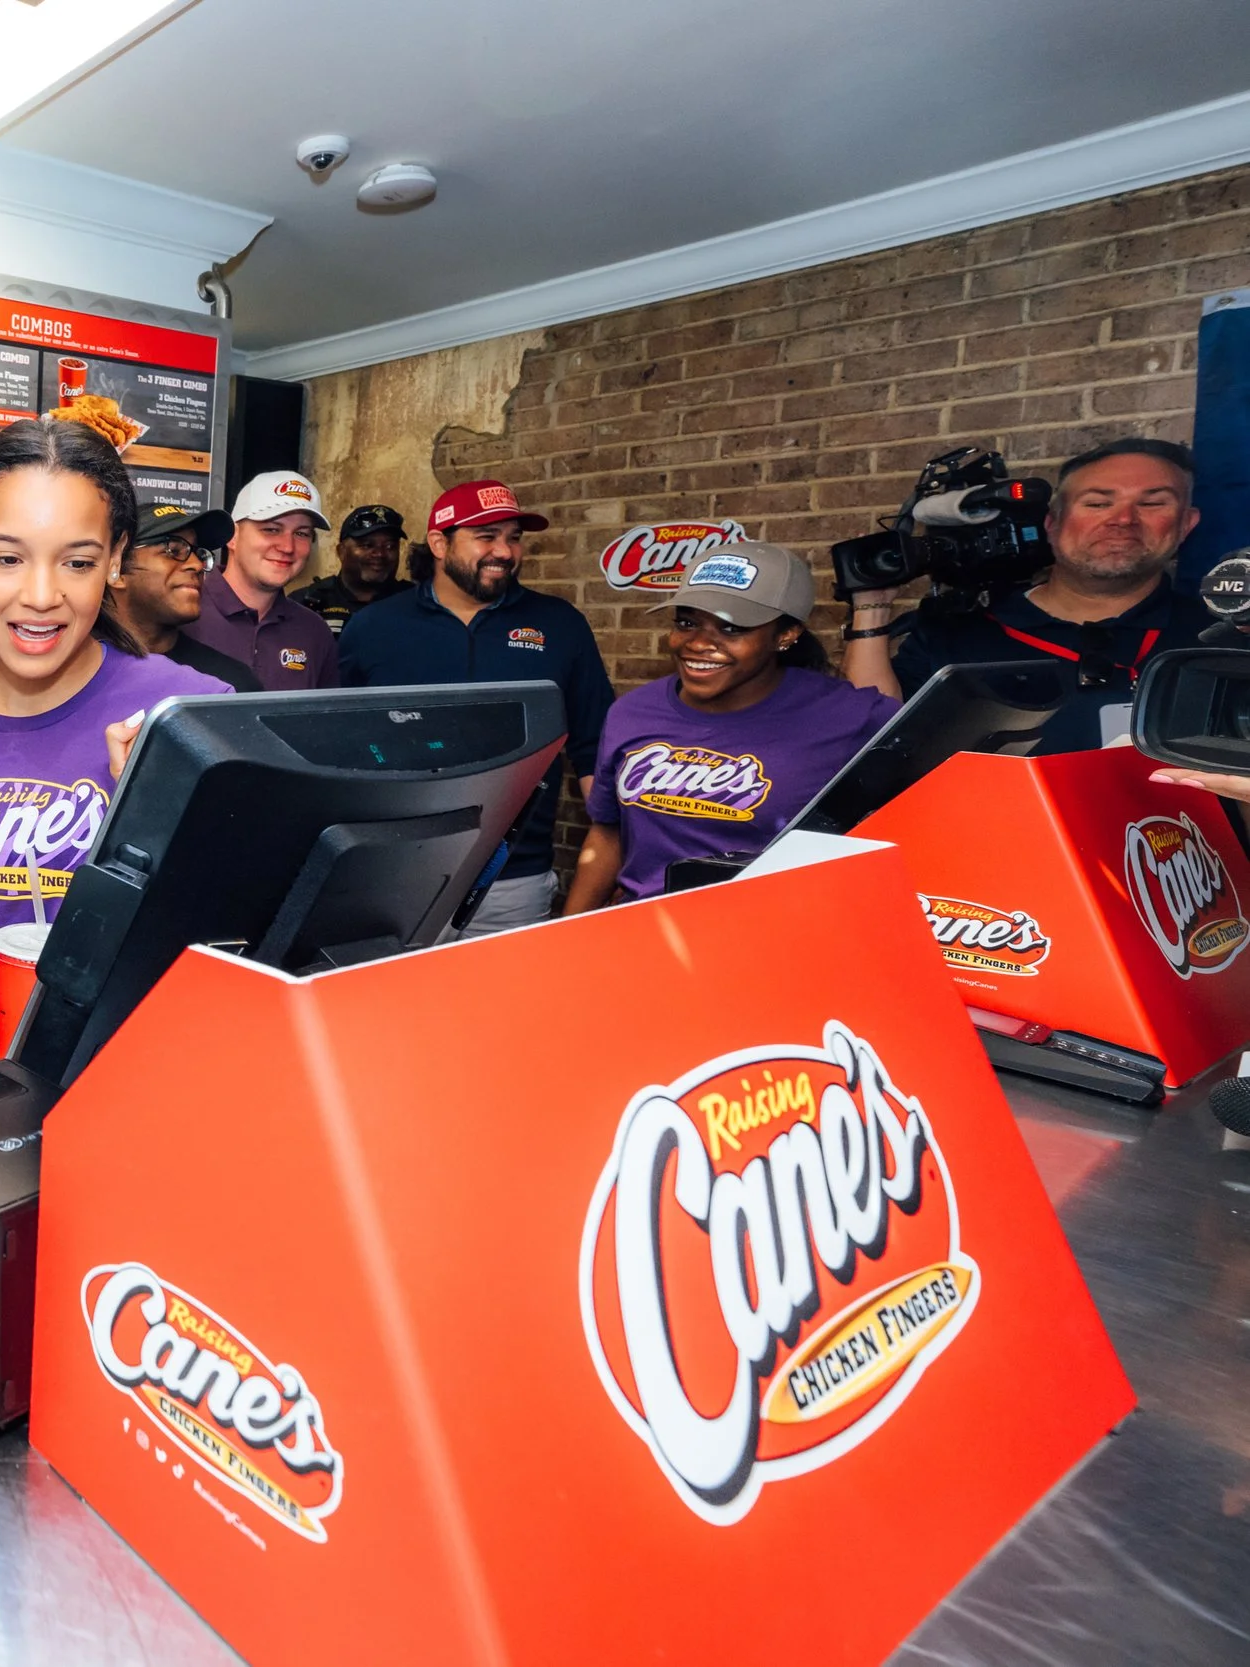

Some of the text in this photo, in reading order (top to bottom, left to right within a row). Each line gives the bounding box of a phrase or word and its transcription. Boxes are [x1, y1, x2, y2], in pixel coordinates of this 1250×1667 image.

[11, 314, 72, 338] COMBOS
[0, 351, 30, 364] COMBO
[4, 370, 30, 382] Fingers
[137, 375, 208, 392] The 3 FINGER COMBO
[163, 394, 186, 404] Chicken
[186, 397, 207, 408] Fingers
[137, 478, 177, 490] SANDWICH
[177, 481, 202, 492] COMBO
[159, 497, 181, 505] Chicken
[181, 499, 202, 508] Fingers
[657, 526, 707, 541] Raising
[692, 572, 750, 585] CHAMPIONS
[702, 562, 747, 576] NATIONAL
[1213, 581, 1244, 592] JVC
[524, 642, 544, 651] LOVE
[669, 751, 723, 769] Raising
[618, 745, 764, 799] Cane's
[650, 795, 738, 818] CHICKEN FINGERS
[1146, 831, 1182, 858] Raising
[1129, 816, 1222, 967] Cane's
[933, 901, 994, 923] Raising
[917, 895, 1047, 952] ane's
[972, 956, 1021, 972] FINGERS
[698, 1069, 816, 1162] Raising
[615, 1030, 925, 1497] Cane's
[168, 1296, 254, 1376] Raising
[787, 1271, 958, 1412] CHICKEN FINGERS
[92, 1266, 336, 1473] Cane's
[159, 1396, 222, 1457] CHICKEN
[227, 1451, 300, 1520] FINGERS
